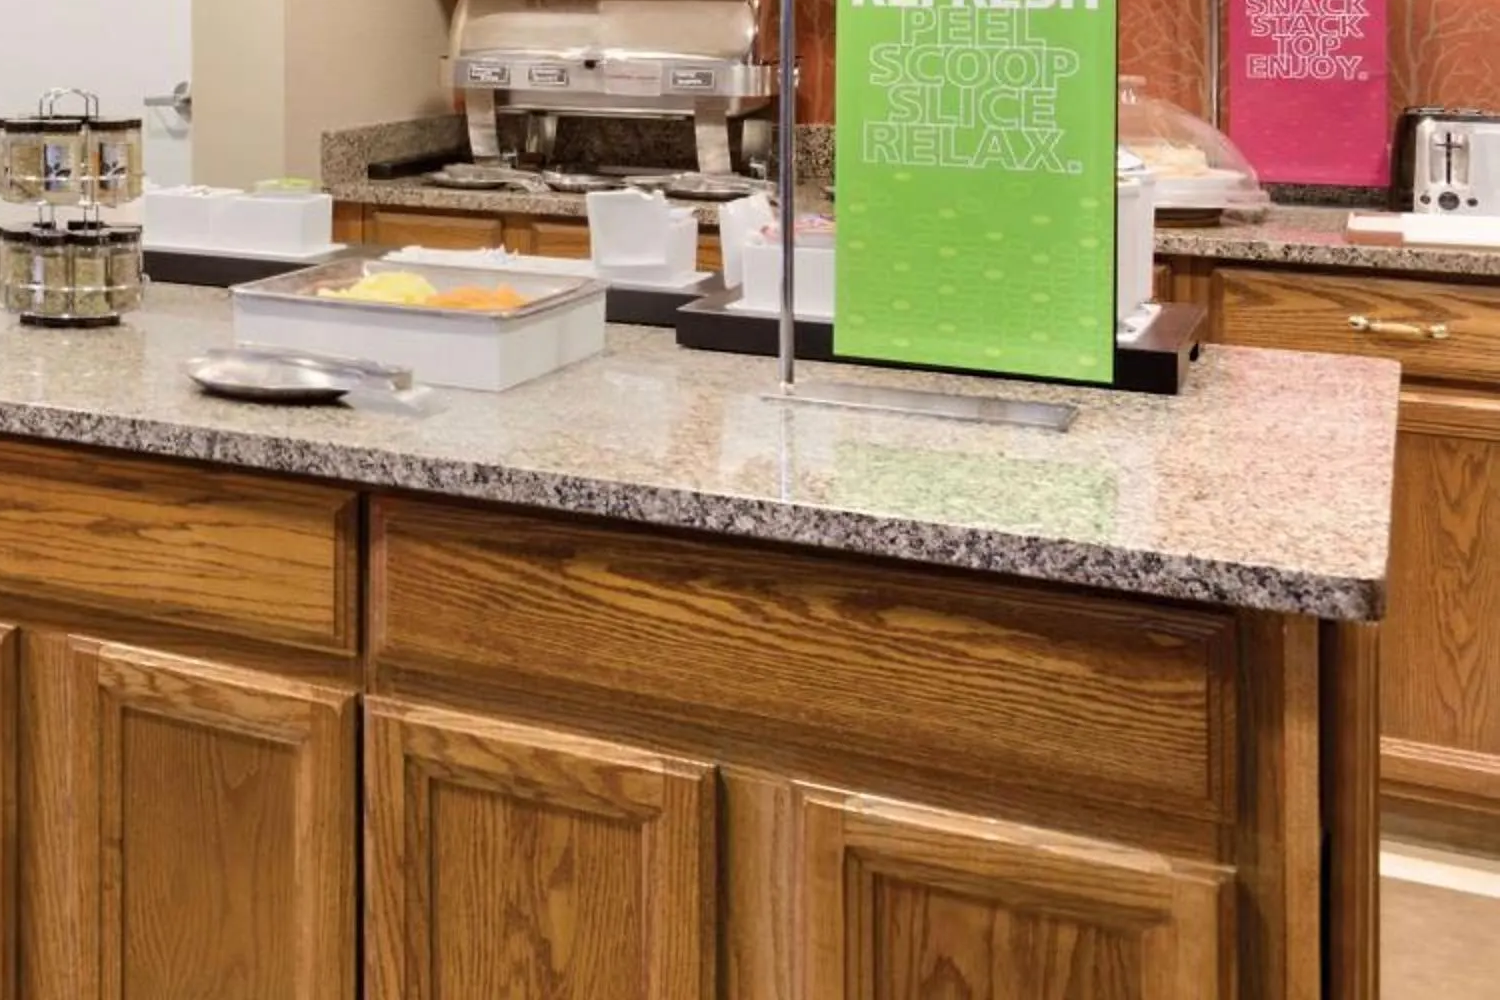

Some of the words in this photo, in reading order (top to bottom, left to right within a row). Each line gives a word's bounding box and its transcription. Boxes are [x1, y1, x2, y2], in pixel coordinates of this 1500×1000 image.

[901, 5, 1046, 48] PEEL
[1251, 14, 1364, 38] STACK
[1271, 34, 1341, 57] TOP
[869, 43, 1080, 91] SCOOP
[1246, 54, 1368, 81] ENJOY.
[887, 84, 1057, 131] SLICE
[863, 121, 1083, 174] RELAX.
